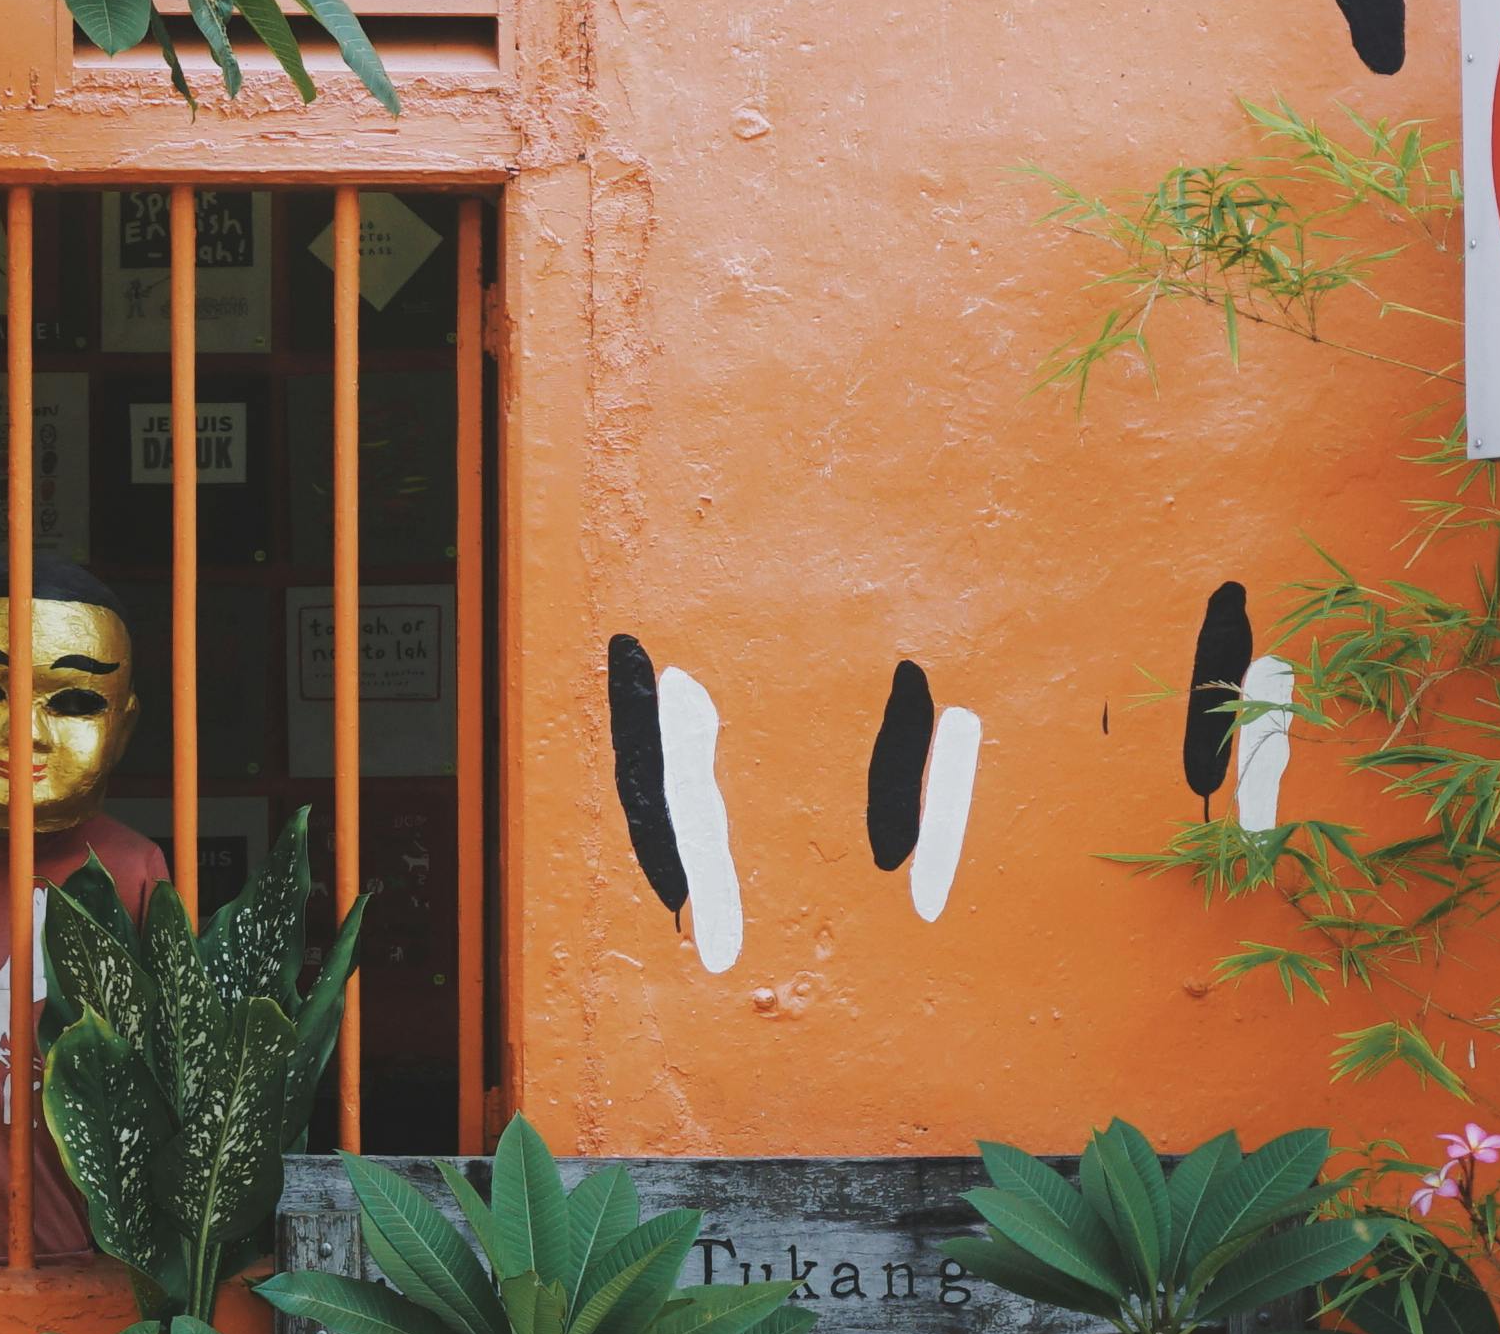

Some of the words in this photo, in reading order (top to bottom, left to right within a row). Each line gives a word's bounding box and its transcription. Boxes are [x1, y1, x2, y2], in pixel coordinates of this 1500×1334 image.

[130, 192, 217, 221] Spk
[125, 210, 243, 244] Enish
[199, 239, 247, 264] ah!
[143, 416, 171, 433] JE
[195, 415, 233, 433] UIS
[143, 436, 233, 470] DAUK
[401, 619, 425, 635] or
[395, 639, 427, 660] lah
